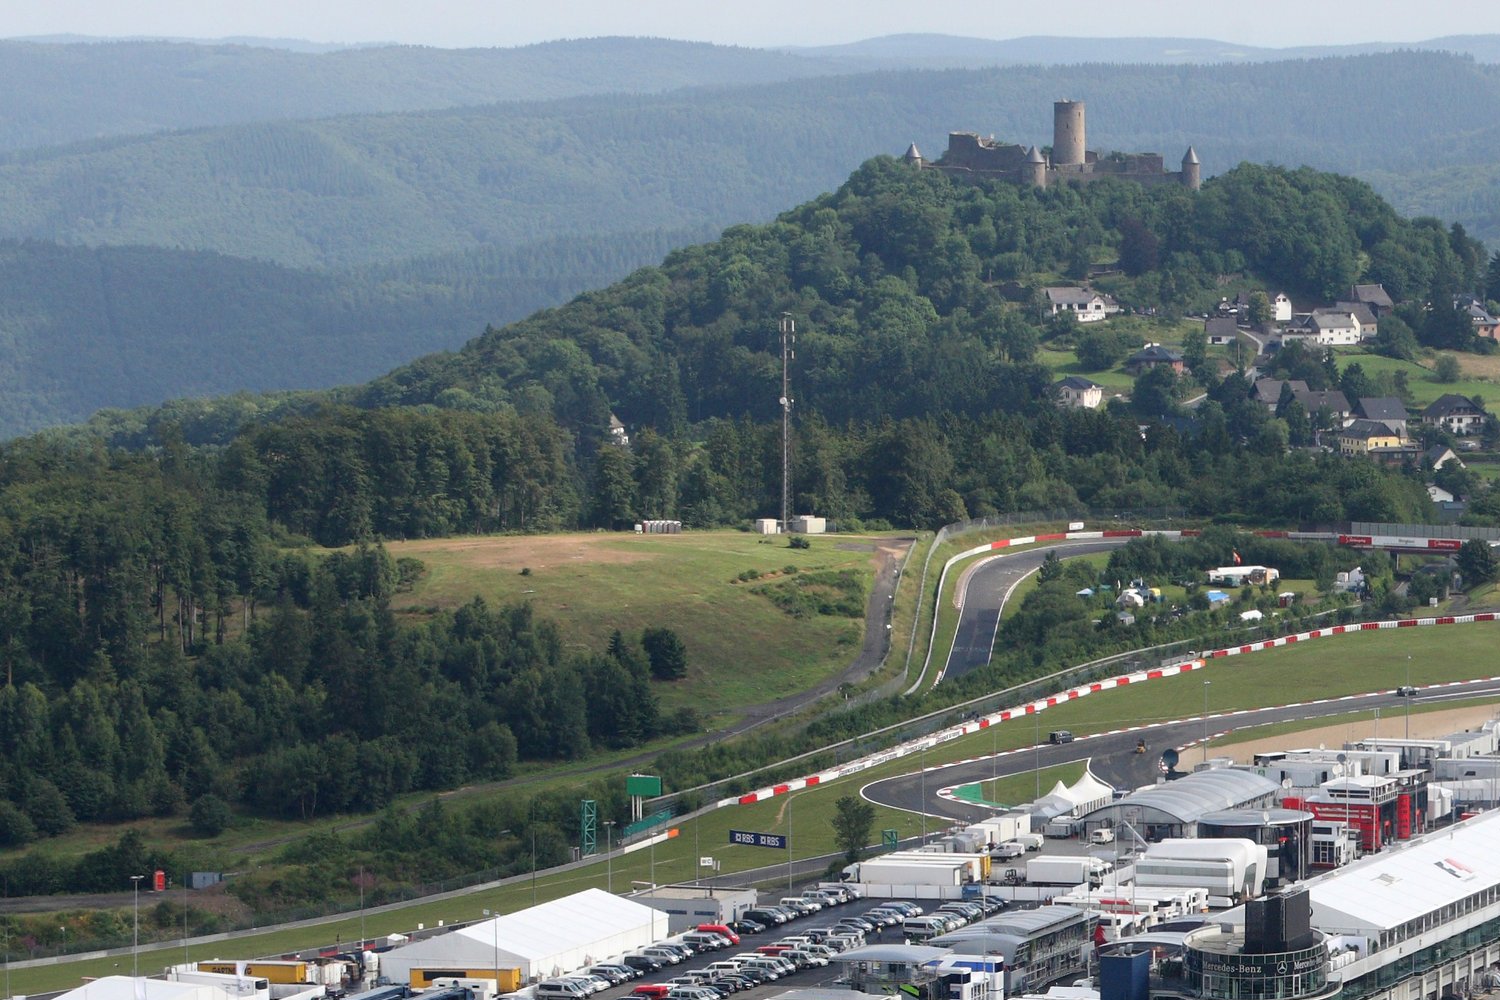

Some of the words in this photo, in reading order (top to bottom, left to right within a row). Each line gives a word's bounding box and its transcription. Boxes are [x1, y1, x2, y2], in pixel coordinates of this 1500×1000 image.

[742, 834, 755, 844] RBS
[766, 836, 779, 846] RBS
[1203, 960, 1262, 973] Mercedes-Benz
